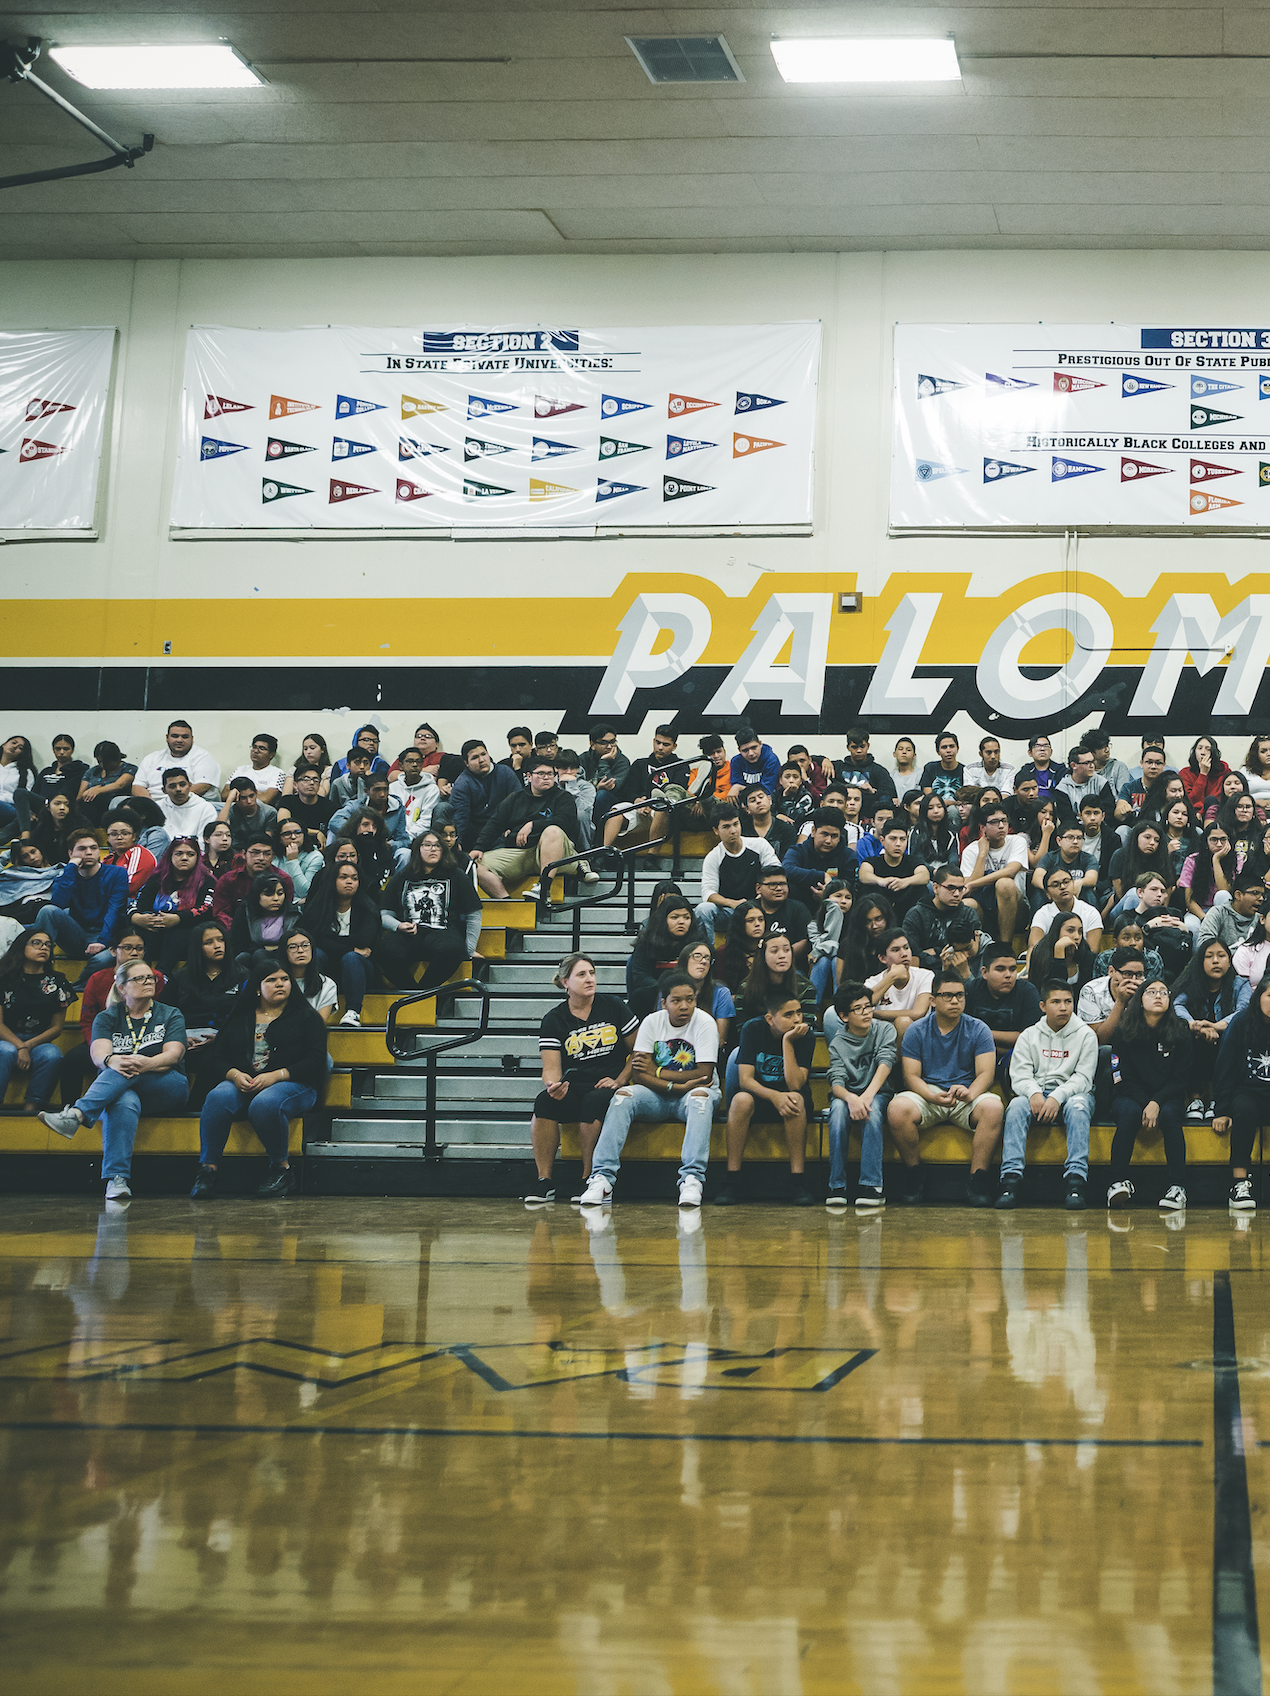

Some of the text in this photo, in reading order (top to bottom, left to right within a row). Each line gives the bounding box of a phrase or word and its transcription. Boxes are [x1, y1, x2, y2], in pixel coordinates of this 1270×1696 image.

[453, 334, 552, 350] SECTION 2
[1170, 331, 1256, 348] SECTION
[452, 357, 510, 370] IVATE
[1058, 353, 1140, 366] PRESTIGIOUS
[1144, 355, 1171, 366] OUT
[1175, 355, 1192, 367] OF
[1195, 355, 1237, 367] STATE
[1123, 437, 1167, 449] BLACK
[1171, 438, 1235, 450] COLLEGES
[1239, 440, 1266, 451] AND
